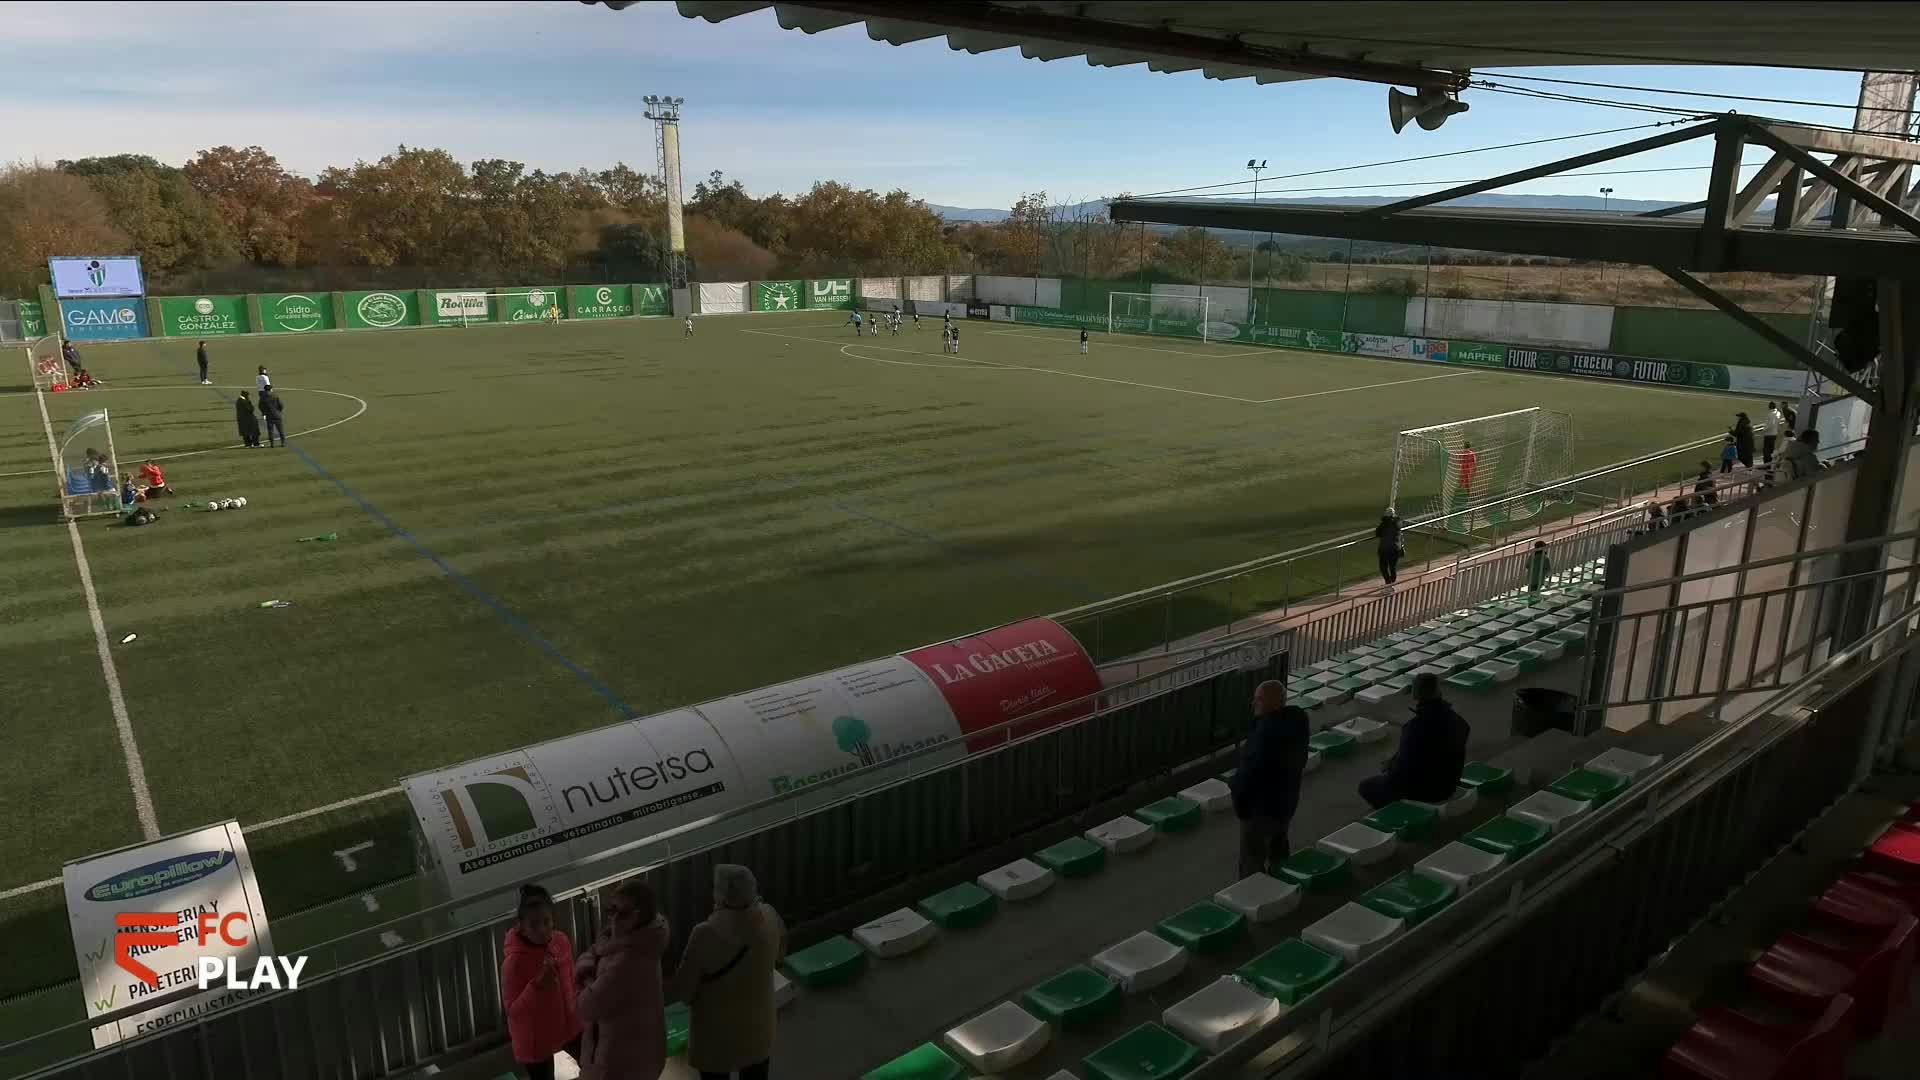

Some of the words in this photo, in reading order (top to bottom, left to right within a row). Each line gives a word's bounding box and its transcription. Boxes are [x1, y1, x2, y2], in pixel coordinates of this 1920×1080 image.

[285, 305, 311, 314] Isidro
[577, 305, 631, 314] CARRASCO
[178, 314, 220, 323] CASTRO
[1458, 351, 1502, 363] MAPFRE
[1573, 355, 1614, 371] TERCERA
[931, 662, 977, 685] LA
[967, 639, 1059, 674] GACETA
[562, 748, 715, 814] nutersa
[562, 815, 623, 840] veterinario
[128, 965, 198, 1000] PALETERI
